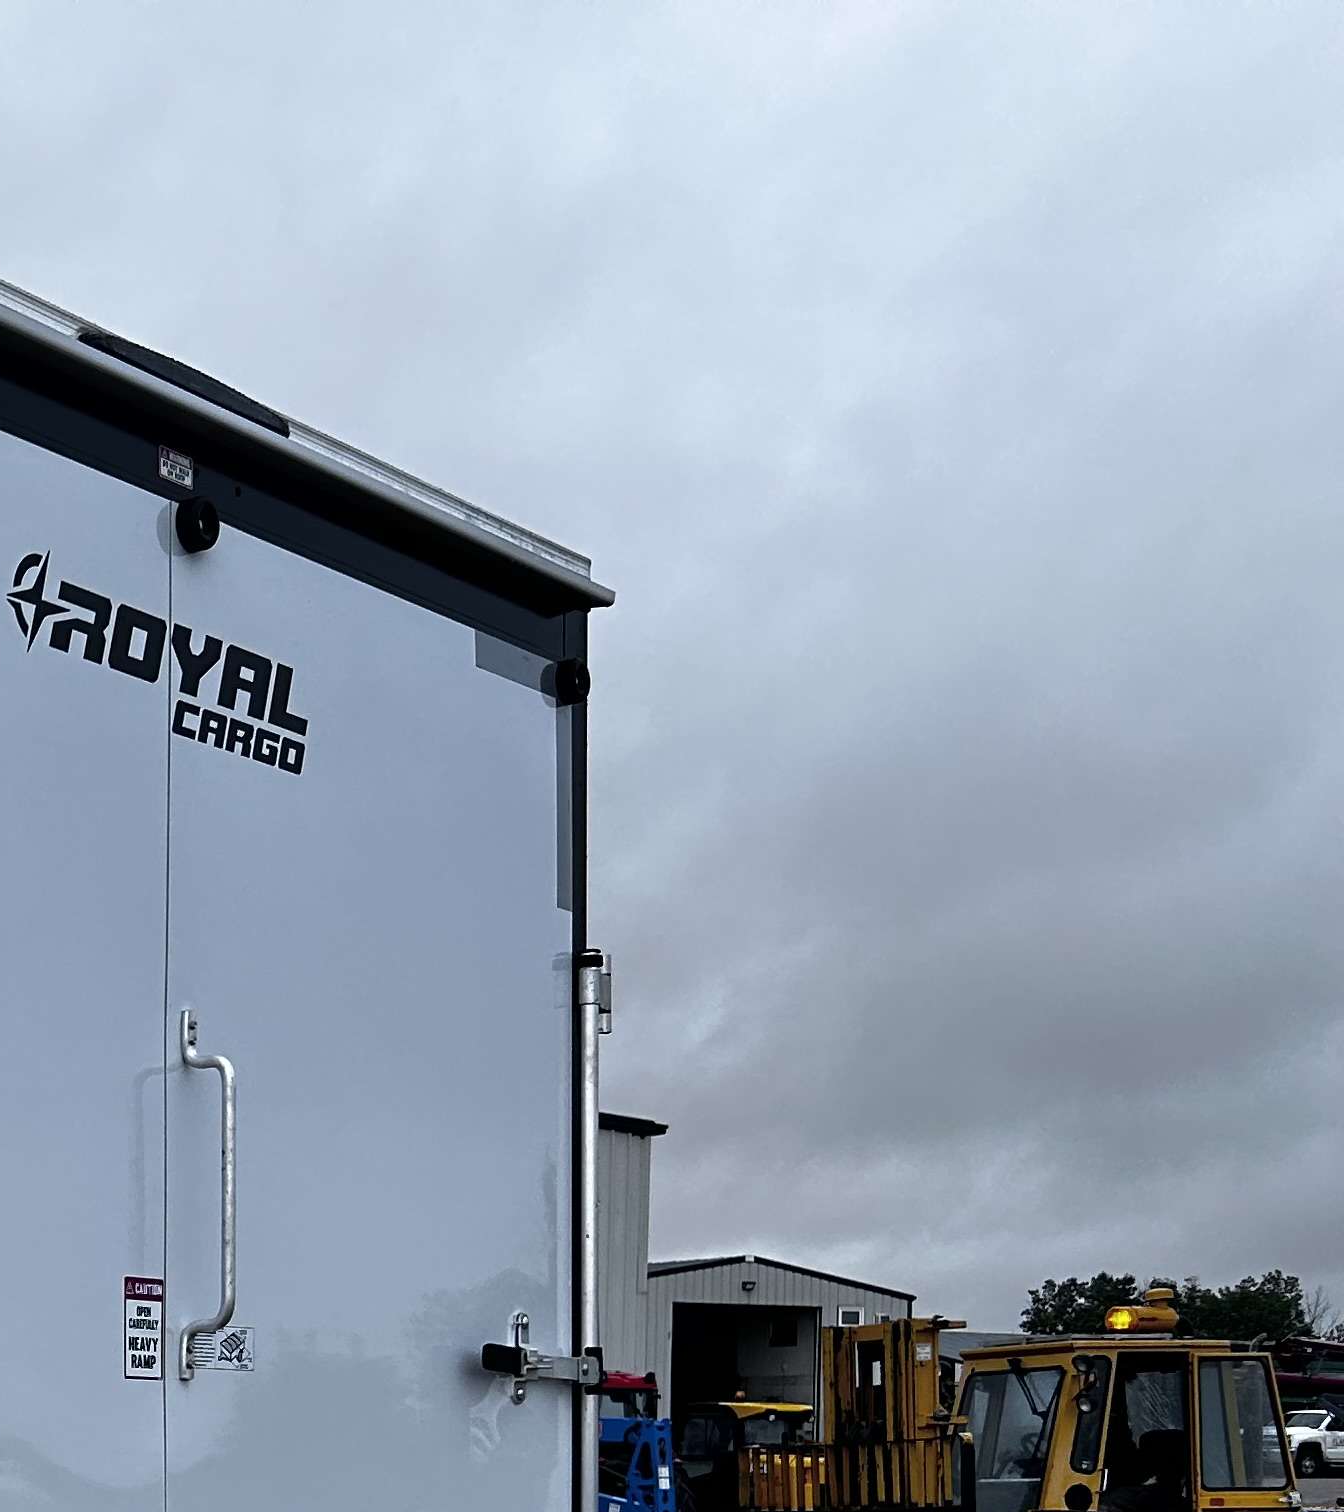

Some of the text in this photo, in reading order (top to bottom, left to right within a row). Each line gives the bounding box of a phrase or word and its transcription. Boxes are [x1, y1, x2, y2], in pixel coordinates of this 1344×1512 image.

[48, 580, 309, 737] ROYAL
[171, 700, 307, 776] CARGO
[135, 1282, 163, 1297] CAUTION
[136, 1305, 152, 1318] OPEN
[128, 1317, 159, 1331] CAREFULLY
[128, 1336, 159, 1352] HEAVY
[130, 1354, 157, 1369] RAMP
